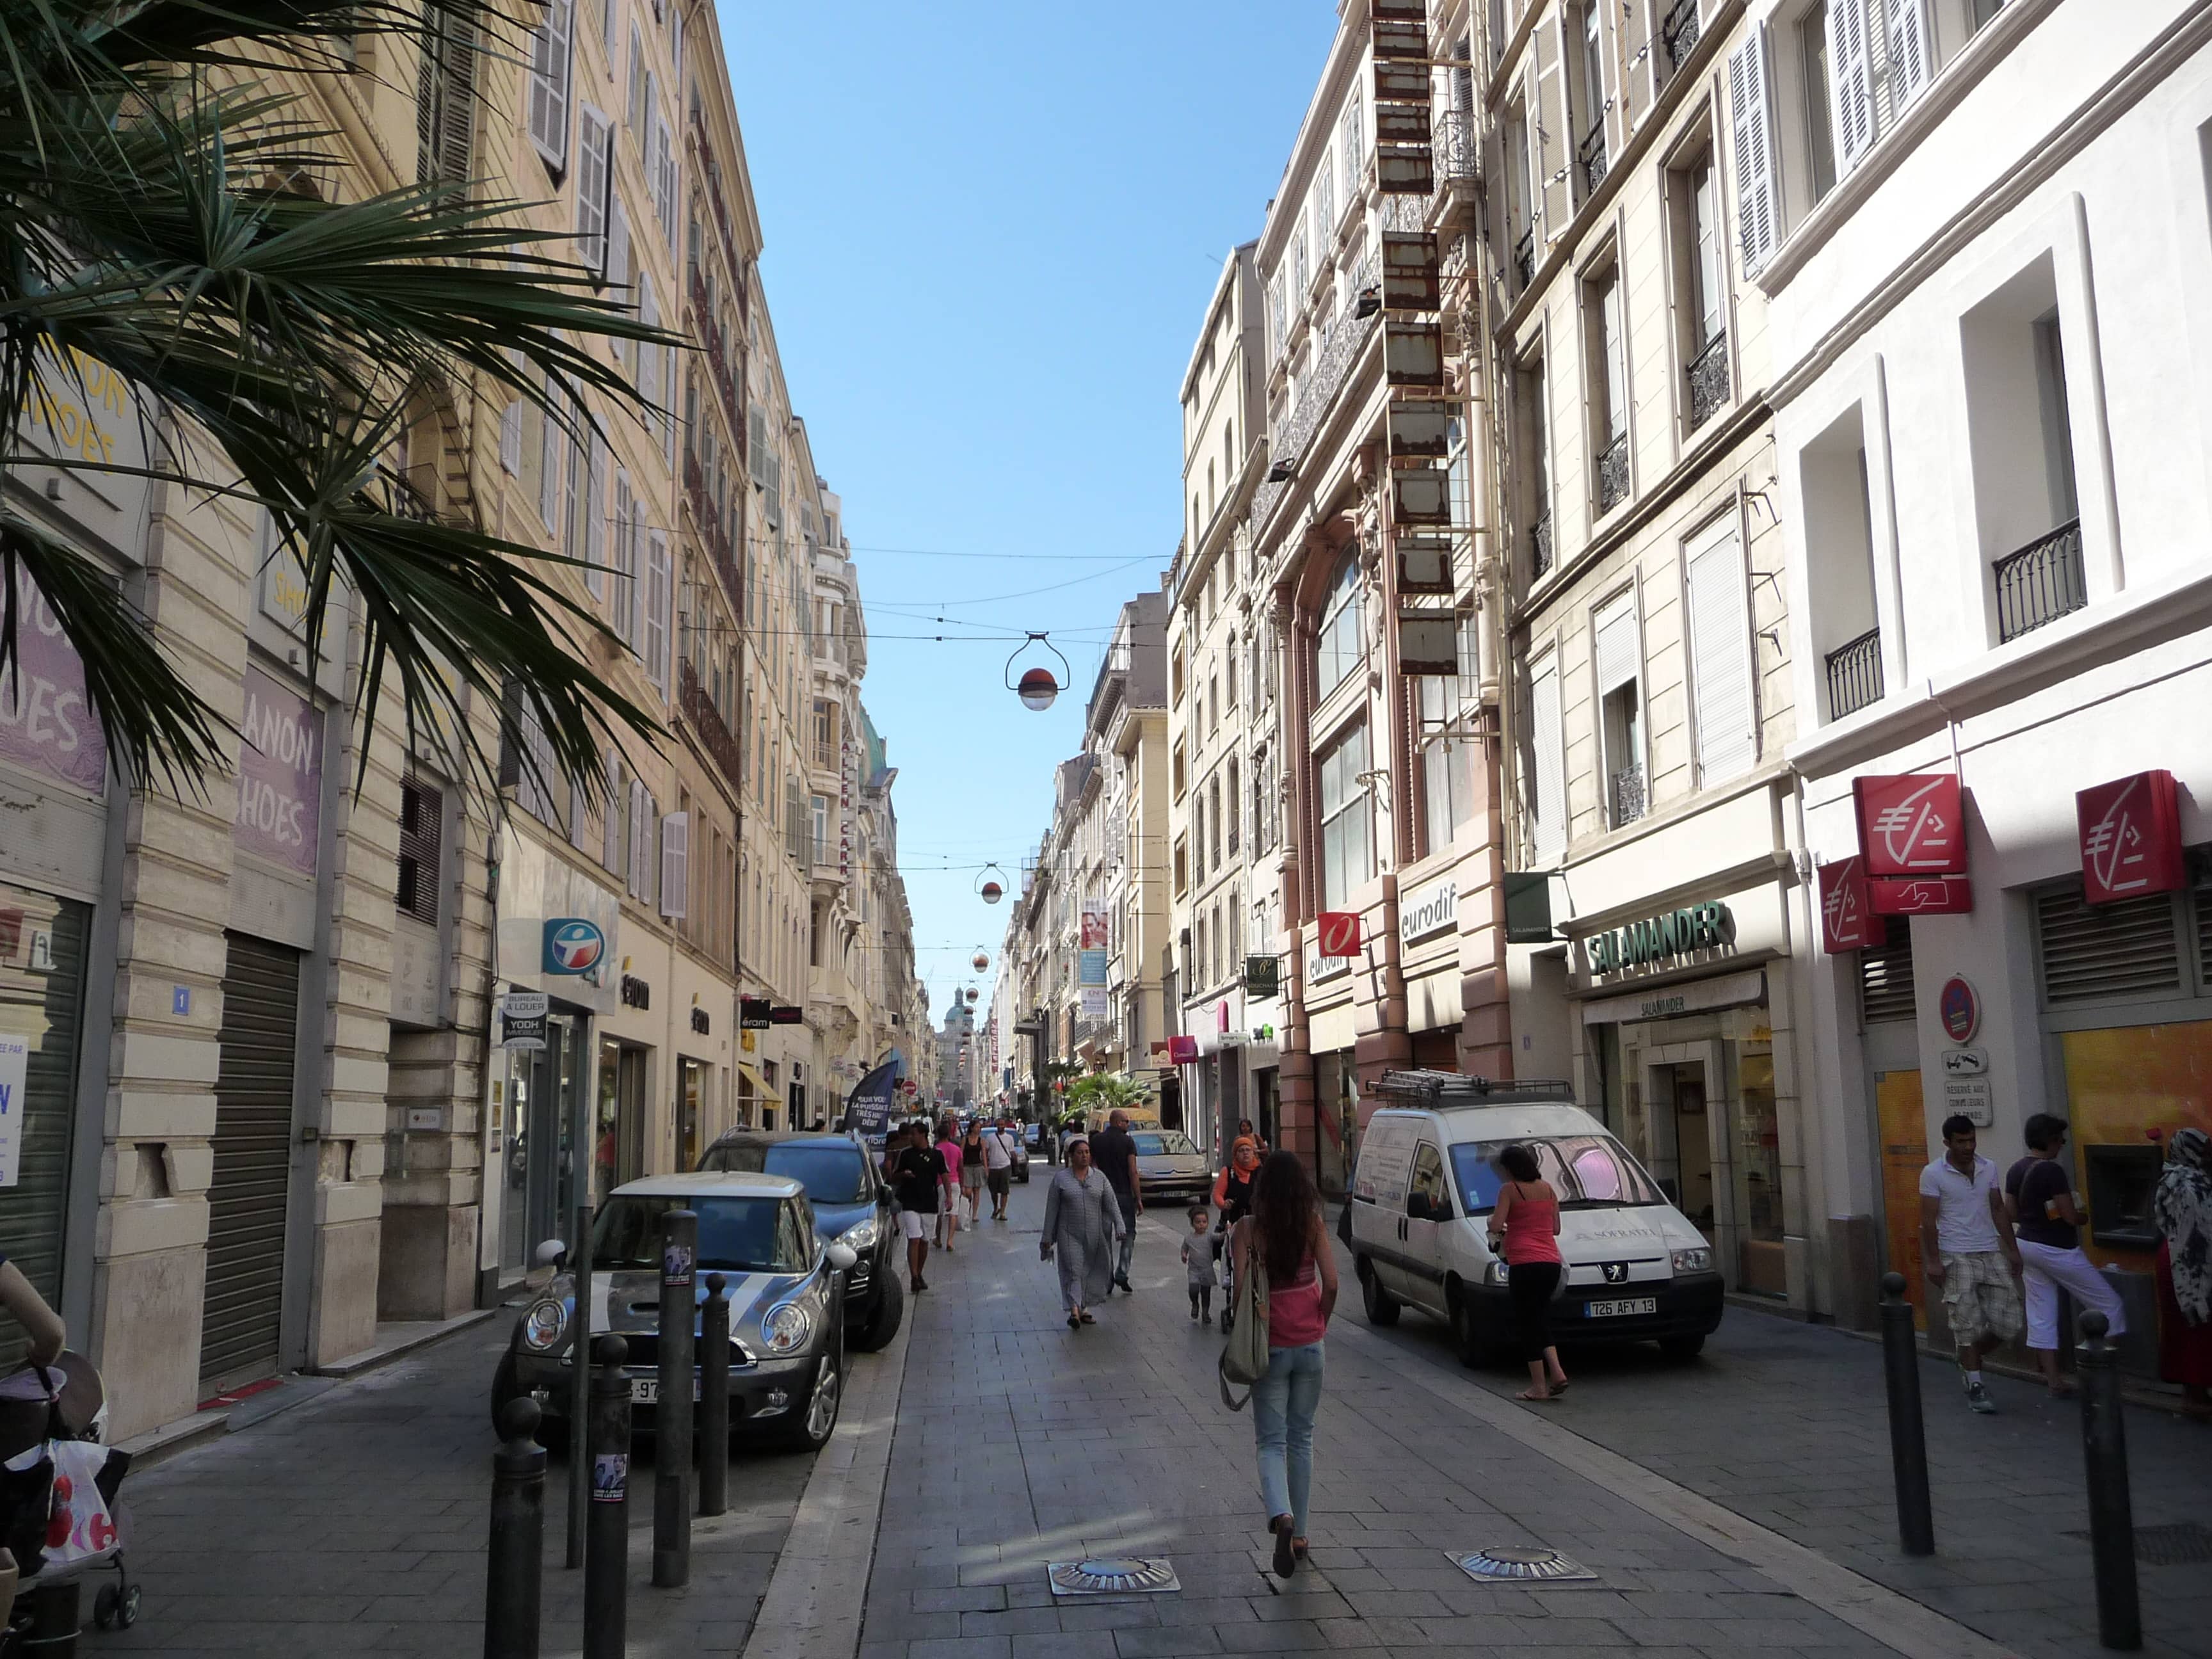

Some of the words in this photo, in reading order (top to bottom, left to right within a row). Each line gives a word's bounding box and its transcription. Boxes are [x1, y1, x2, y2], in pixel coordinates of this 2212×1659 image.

[1402, 882, 1457, 938] eurodif
[1589, 900, 1723, 975] SALAMANDER
[179, 993, 184, 1008] 1
[1641, 996, 1685, 1016] SALAMANDER
[742, 1017, 767, 1027] éram
[1592, 1302, 1612, 1315] 726
[1617, 1301, 1636, 1314] AFY
[1642, 1299, 1655, 1312] 13
